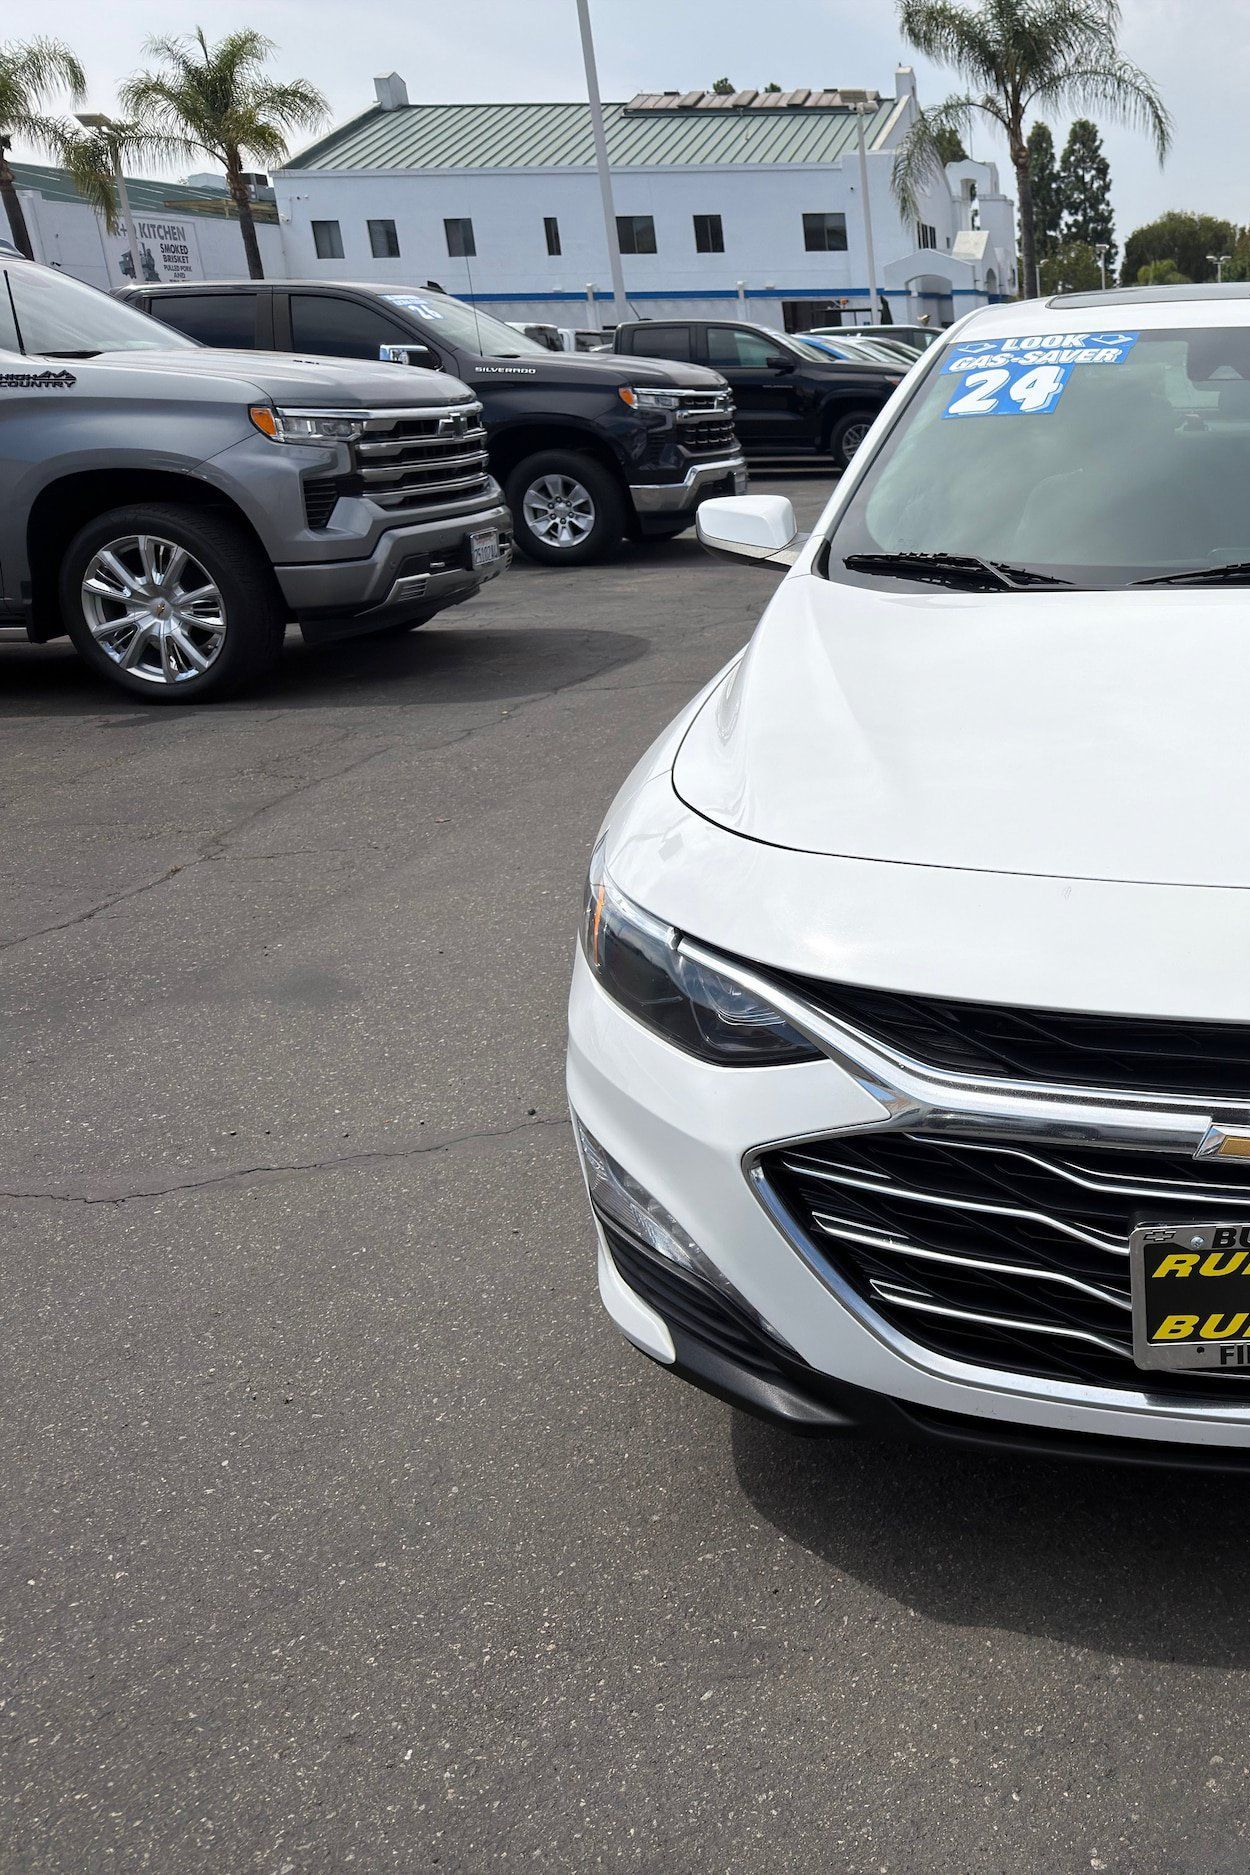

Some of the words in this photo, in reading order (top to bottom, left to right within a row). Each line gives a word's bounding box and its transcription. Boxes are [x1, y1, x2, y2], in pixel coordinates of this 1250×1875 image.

[138, 222, 186, 241] KITCHEN
[160, 243, 188, 255] SMOKED
[162, 254, 189, 264] BRISKET
[1001, 334, 1092, 351] LOOK
[948, 348, 1123, 373] GAS-SAVER
[475, 366, 536, 374] SILVERADO
[948, 365, 1066, 415] 24
